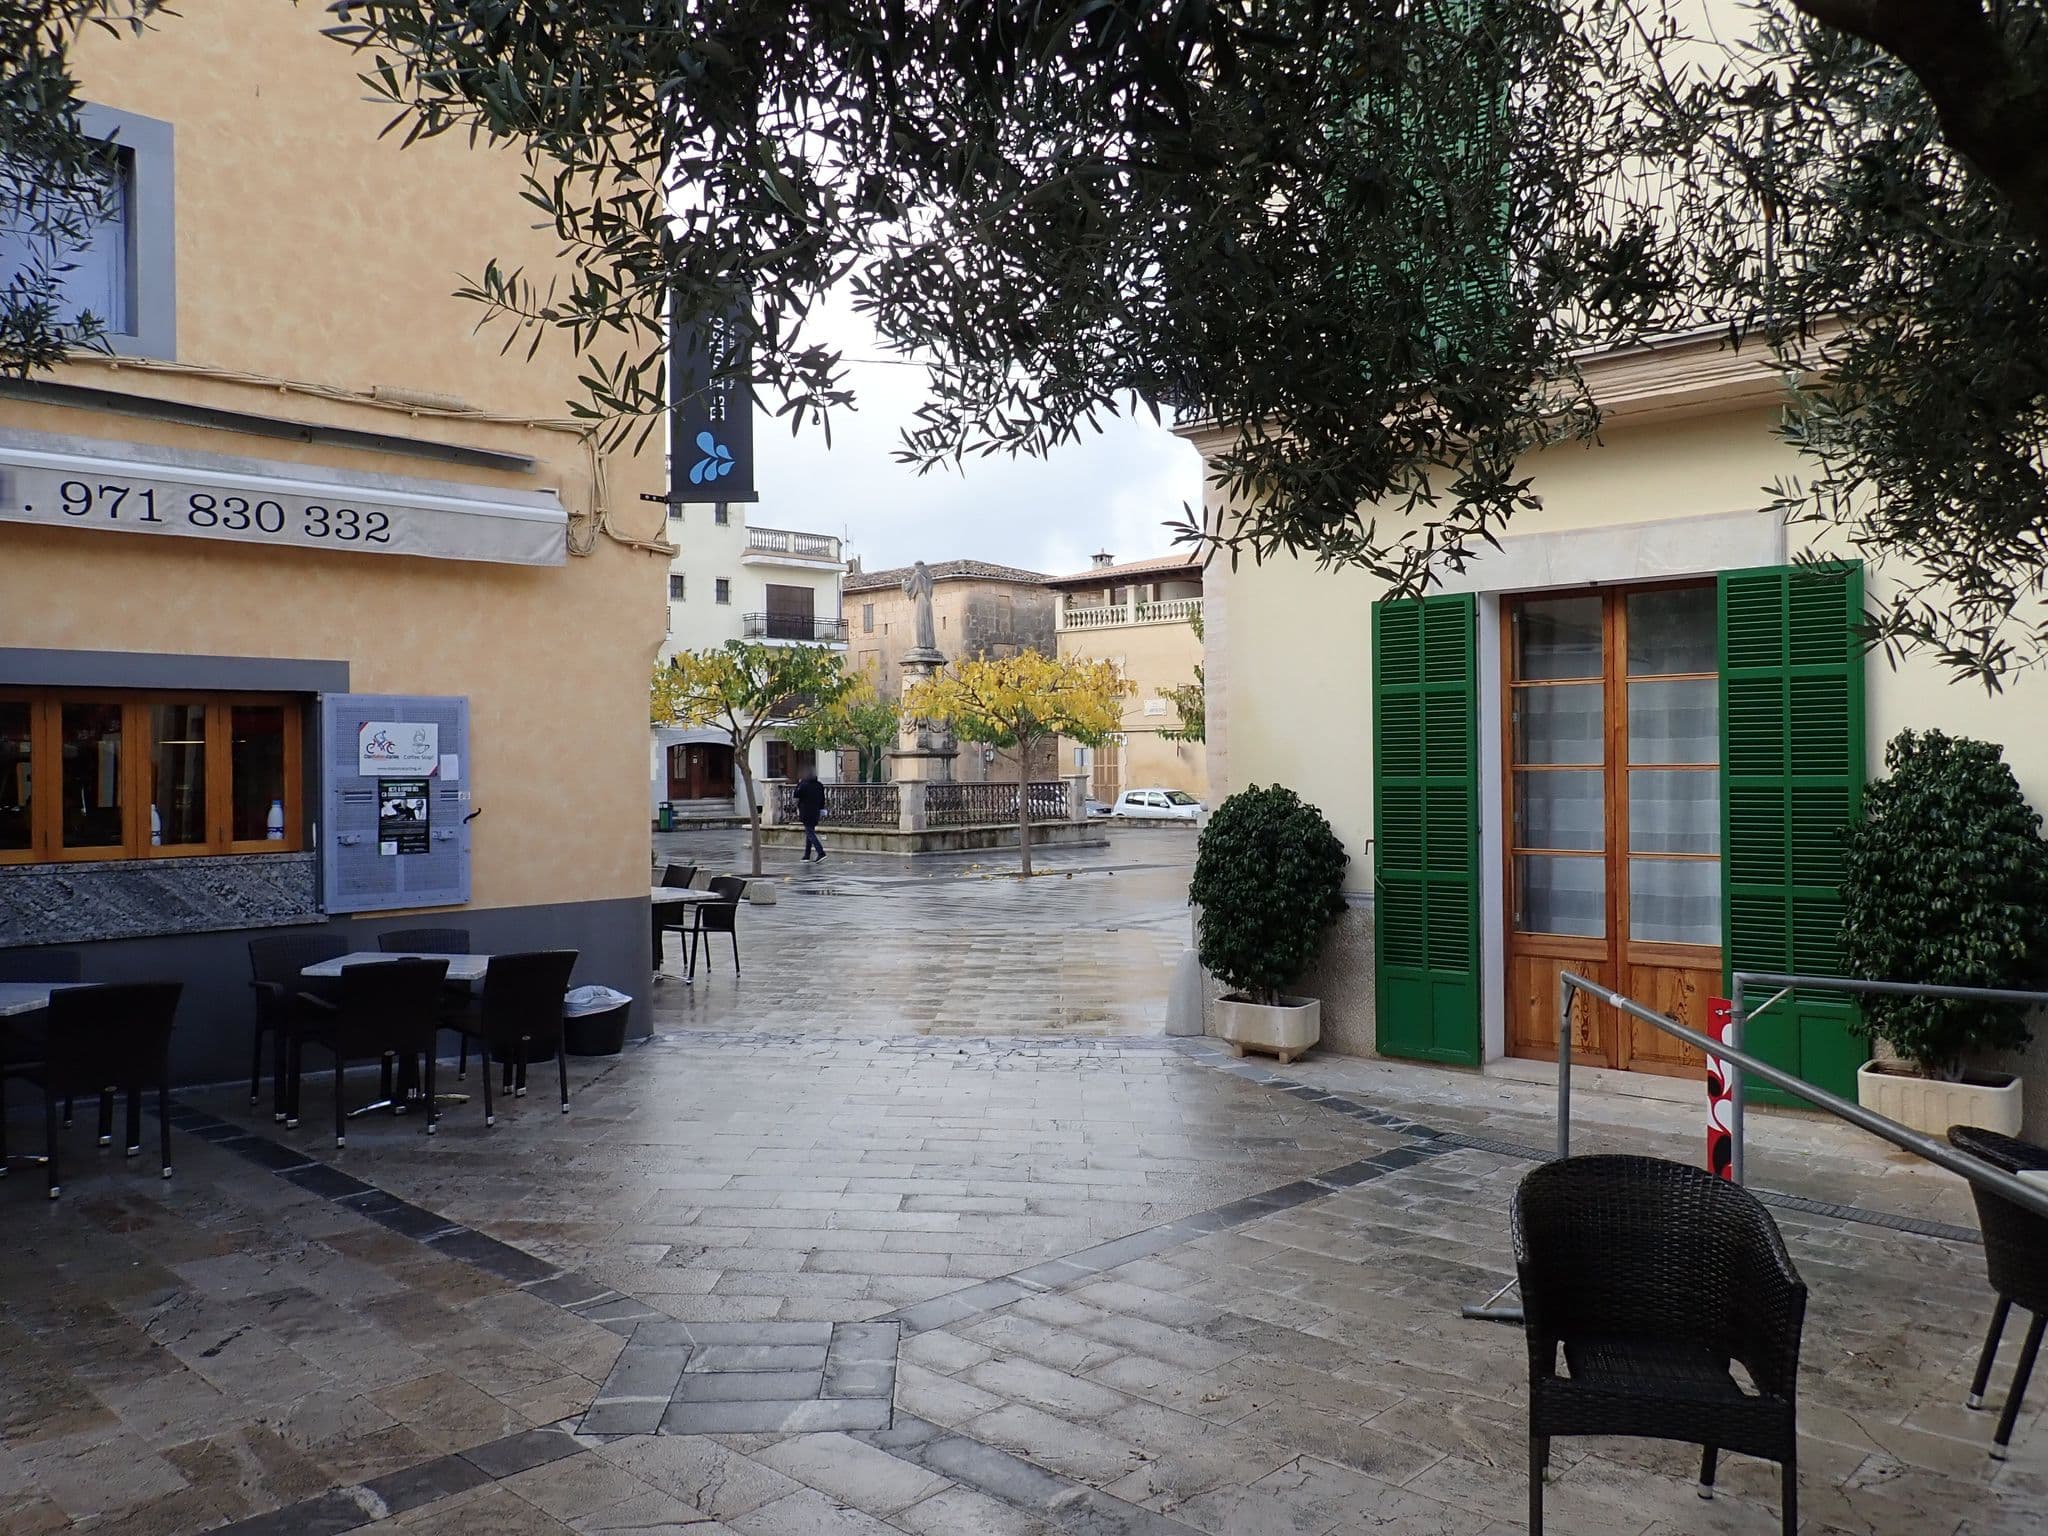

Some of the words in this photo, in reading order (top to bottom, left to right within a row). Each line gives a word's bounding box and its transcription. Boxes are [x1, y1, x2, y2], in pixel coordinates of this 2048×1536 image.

[60, 480, 163, 523] 971
[188, 493, 285, 533] 830
[304, 505, 391, 543] 332
